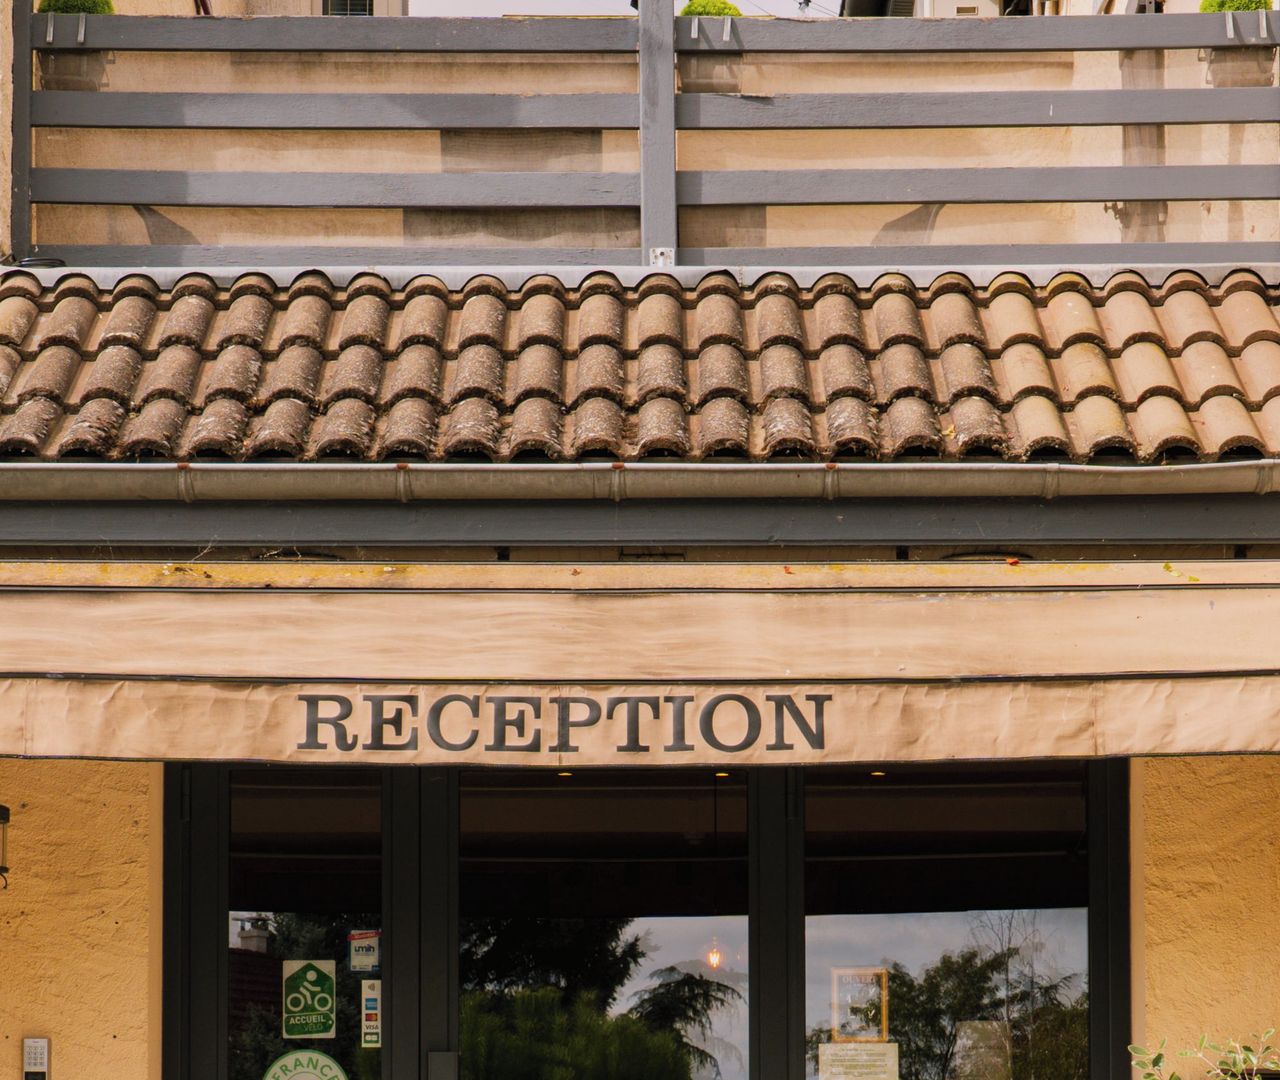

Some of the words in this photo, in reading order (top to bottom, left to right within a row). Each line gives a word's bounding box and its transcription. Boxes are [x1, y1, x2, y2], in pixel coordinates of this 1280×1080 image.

[296, 693, 833, 753] RECEPTION
[289, 1015, 326, 1025] ACCUEIL
[303, 1023, 323, 1032] VÉLO
